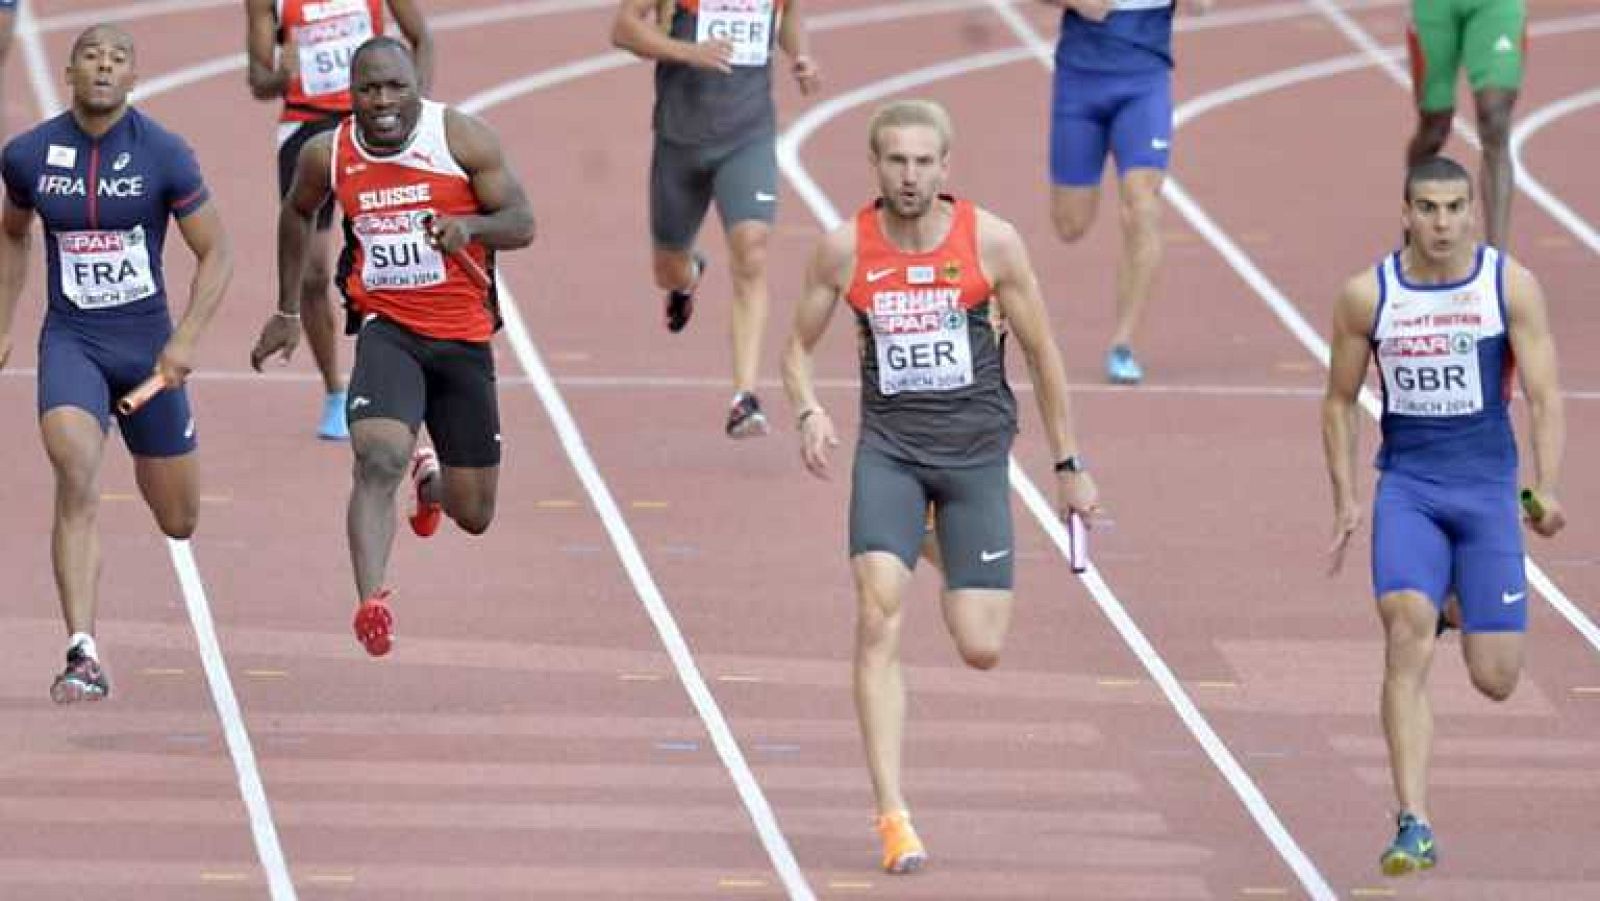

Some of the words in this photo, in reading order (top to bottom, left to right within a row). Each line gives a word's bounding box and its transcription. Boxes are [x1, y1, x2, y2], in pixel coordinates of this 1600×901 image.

[708, 19, 764, 43] GER
[316, 47, 351, 73] SU
[359, 183, 432, 209] SUISSE
[371, 243, 420, 268] SUI
[74, 258, 138, 285] FRA
[874, 288, 962, 315] GERMANY
[887, 342, 957, 370] GER
[1394, 367, 1466, 391] GBR
